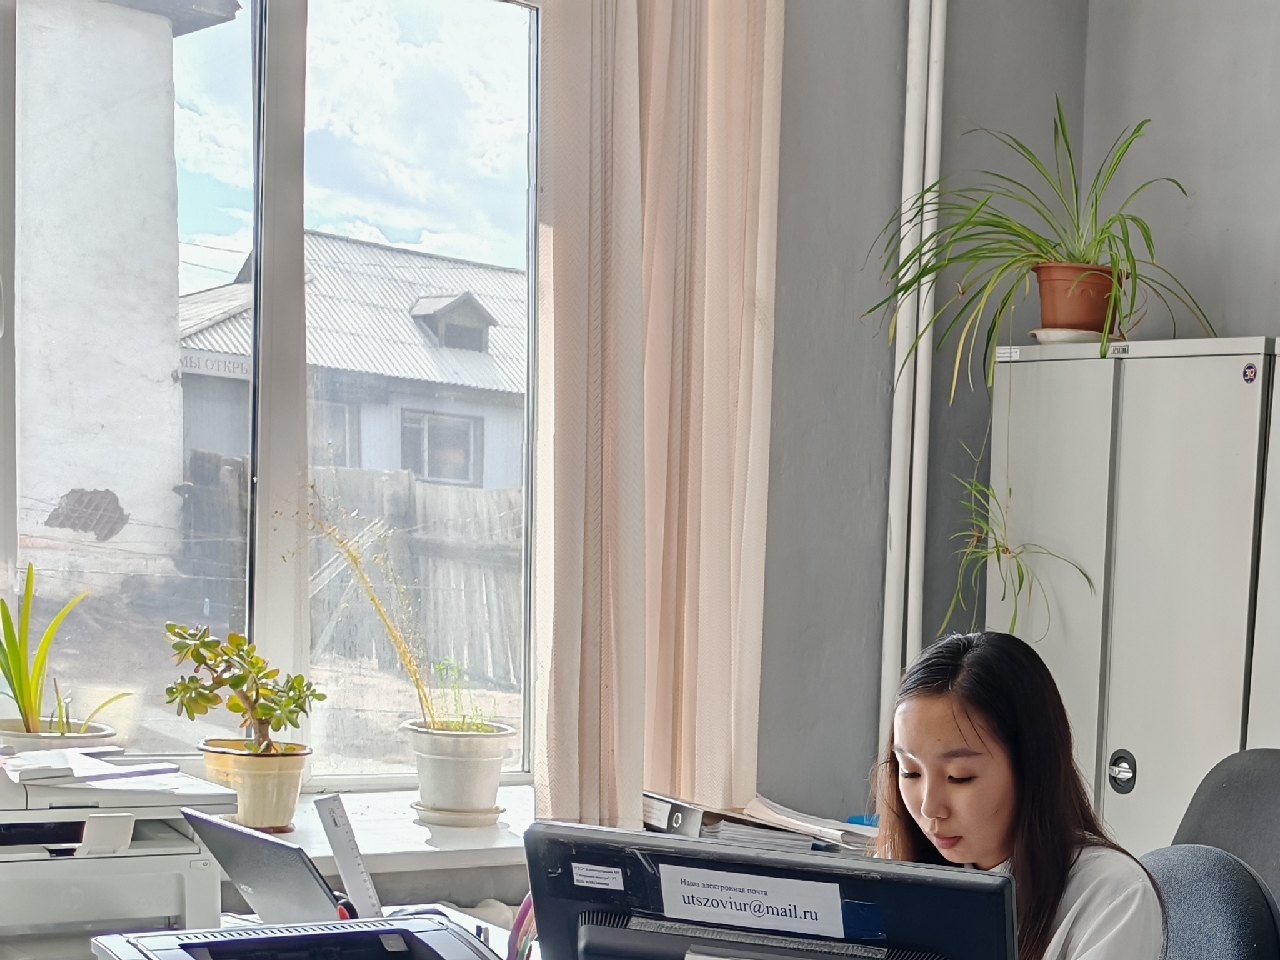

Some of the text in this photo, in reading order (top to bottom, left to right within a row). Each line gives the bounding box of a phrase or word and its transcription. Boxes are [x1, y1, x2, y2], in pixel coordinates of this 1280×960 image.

[701, 882, 745, 894] электронная
[746, 887, 768, 896] почта
[681, 893, 818, 921] utszoviur@mail.ru
